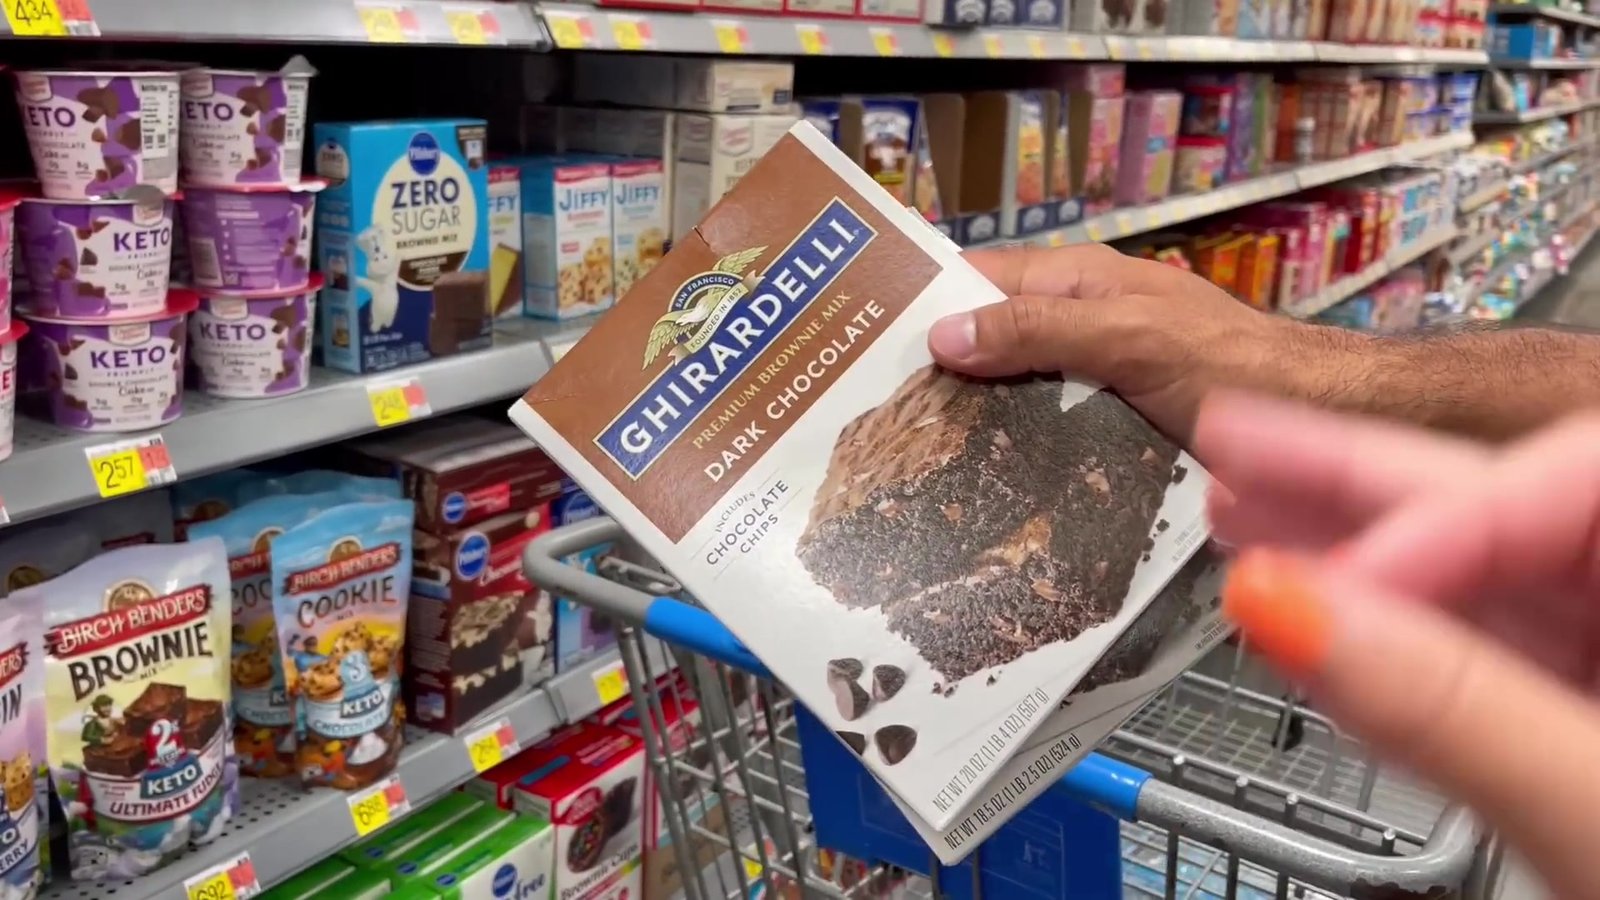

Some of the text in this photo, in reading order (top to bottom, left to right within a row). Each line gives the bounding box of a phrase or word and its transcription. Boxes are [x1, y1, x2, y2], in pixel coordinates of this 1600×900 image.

[22, 105, 76, 127] ETO
[183, 101, 233, 121] ETO
[391, 177, 460, 210] ZERO
[559, 188, 609, 211] JIFFY
[616, 184, 659, 205] JIFFY
[391, 206, 461, 236] SUGAR
[113, 226, 170, 252] KETO
[396, 233, 459, 250] BROWNIE MIX
[675, 276, 735, 308] SAN FRANCISCO
[200, 323, 266, 341] KETO
[690, 287, 742, 349] FOUNDED IN 1852
[620, 218, 857, 454] GHIRARDELLI
[90, 346, 165, 369] KETO
[693, 290, 851, 450] PREMIUM BROWNIE MIX
[704, 300, 886, 482] DARK CHOCOLATE
[100, 456, 134, 489] 257
[706, 480, 789, 565] CHOCOLATE
[715, 491, 756, 533] INCLUDES
[740, 514, 778, 553] CHIPS
[291, 566, 338, 592] BIRCH
[297, 575, 397, 629] COOKIE
[58, 589, 206, 654] BIRCH BENDERS
[68, 622, 213, 702] BROWNIE
[341, 691, 385, 716] KETO
[932, 687, 1050, 813] NET WT 20 OZ (1 LB 4 OZ) (567 g)
[110, 762, 221, 816] ULTIMATE FUDGE
[147, 764, 198, 795] KETO
[944, 732, 1082, 850] NET WT 18.5 OZ (1 LB 2.5 OZ) (524 g)
